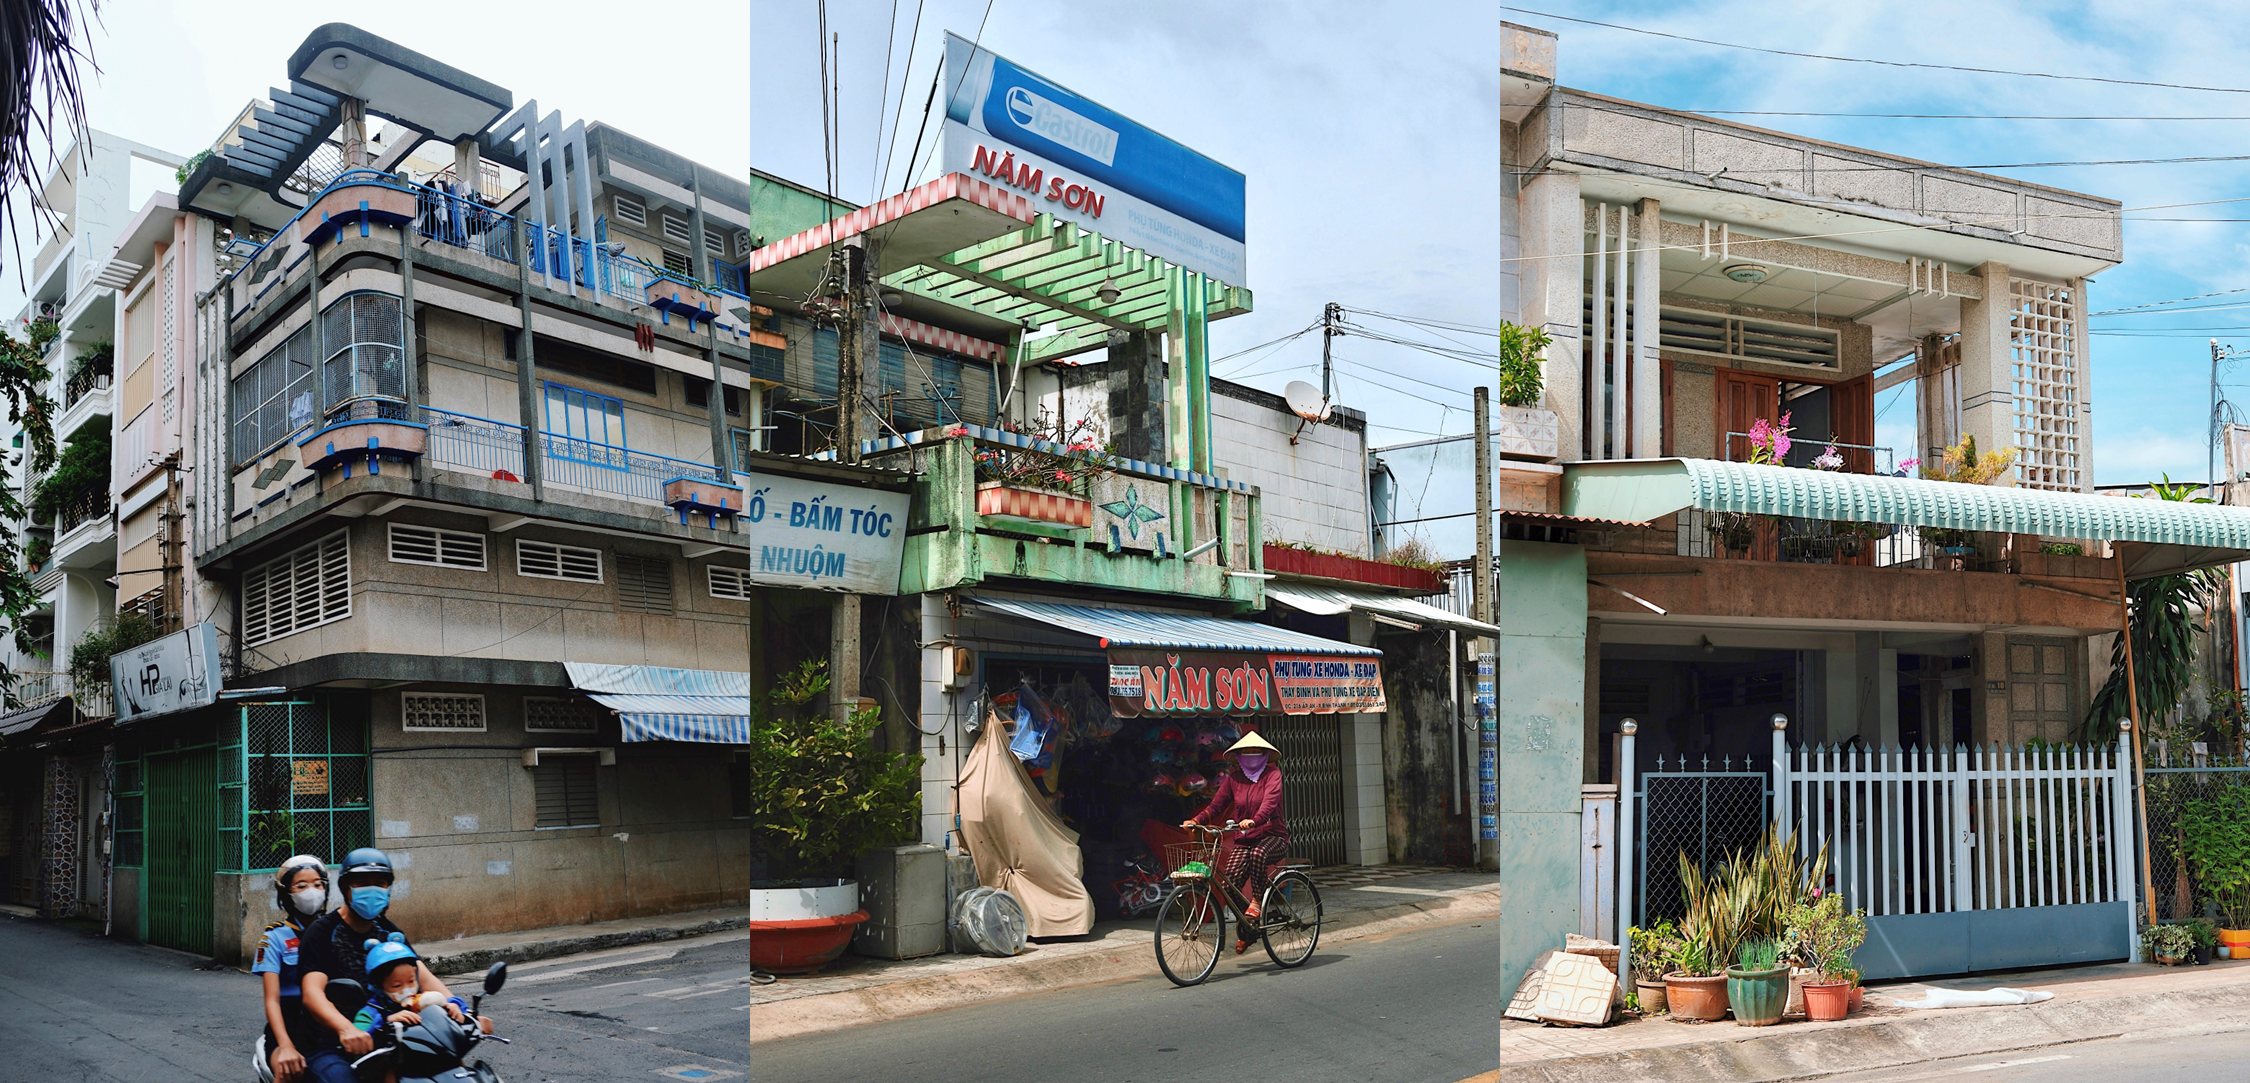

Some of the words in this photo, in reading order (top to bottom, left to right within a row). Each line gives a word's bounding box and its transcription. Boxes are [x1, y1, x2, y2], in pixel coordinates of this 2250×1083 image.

[1034, 101, 1111, 160] Castrol
[971, 144, 1043, 195] NĂM
[1045, 177, 1106, 219] SƠN
[1128, 209, 1147, 229] PHỤ
[1149, 216, 1173, 237] TÙNG
[1174, 229, 1204, 250] HONDA
[1209, 243, 1220, 256] XE
[1221, 248, 1238, 265] ĐẠP
[790, 495, 843, 532] BẤM
[850, 504, 892, 538] TÓC
[760, 543, 846, 581] NHUỘM
[1141, 653, 1212, 711] NĂM
[1215, 660, 1270, 711] SƠN
[1274, 661, 1290, 683] PHỤ
[1314, 662, 1323, 679] XE
[1324, 662, 1350, 679] HONDA
[1354, 662, 1363, 679] XE
[1363, 662, 1378, 683] ĐẠP
[1281, 686, 1295, 698] THAY
[1296, 684, 1311, 698] BÌNH
[1321, 686, 1332, 700] PHỤ
[1349, 686, 1356, 698] XE
[1356, 686, 1367, 700] ĐẠP
